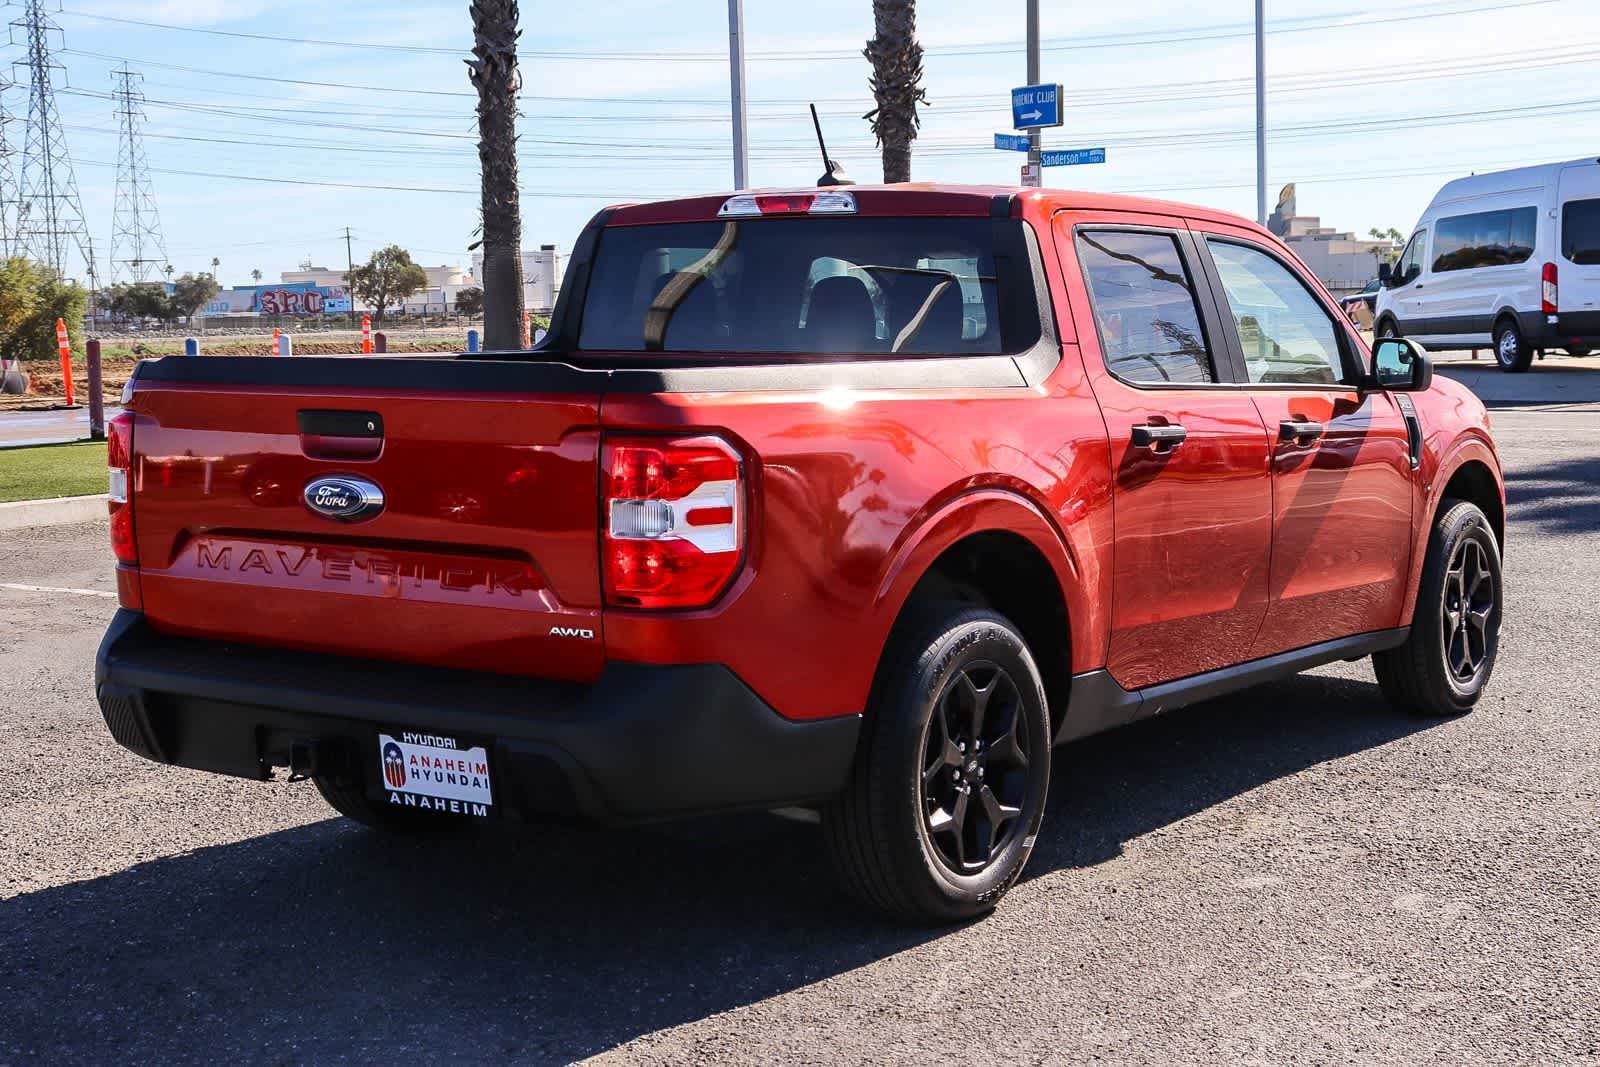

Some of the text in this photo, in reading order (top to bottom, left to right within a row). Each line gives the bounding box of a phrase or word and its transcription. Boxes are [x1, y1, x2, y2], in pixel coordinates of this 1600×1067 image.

[1037, 91, 1055, 104] CLUB
[1042, 153, 1079, 166] Sanderson
[315, 485, 350, 508] Ford
[196, 543, 523, 596] MAVERICK
[549, 626, 594, 639] AWD
[402, 732, 457, 749] HYUNDAI
[409, 754, 487, 775] ANAHEIM
[411, 768, 489, 789] HYUNDAI
[390, 792, 487, 817] ANAHEIM
